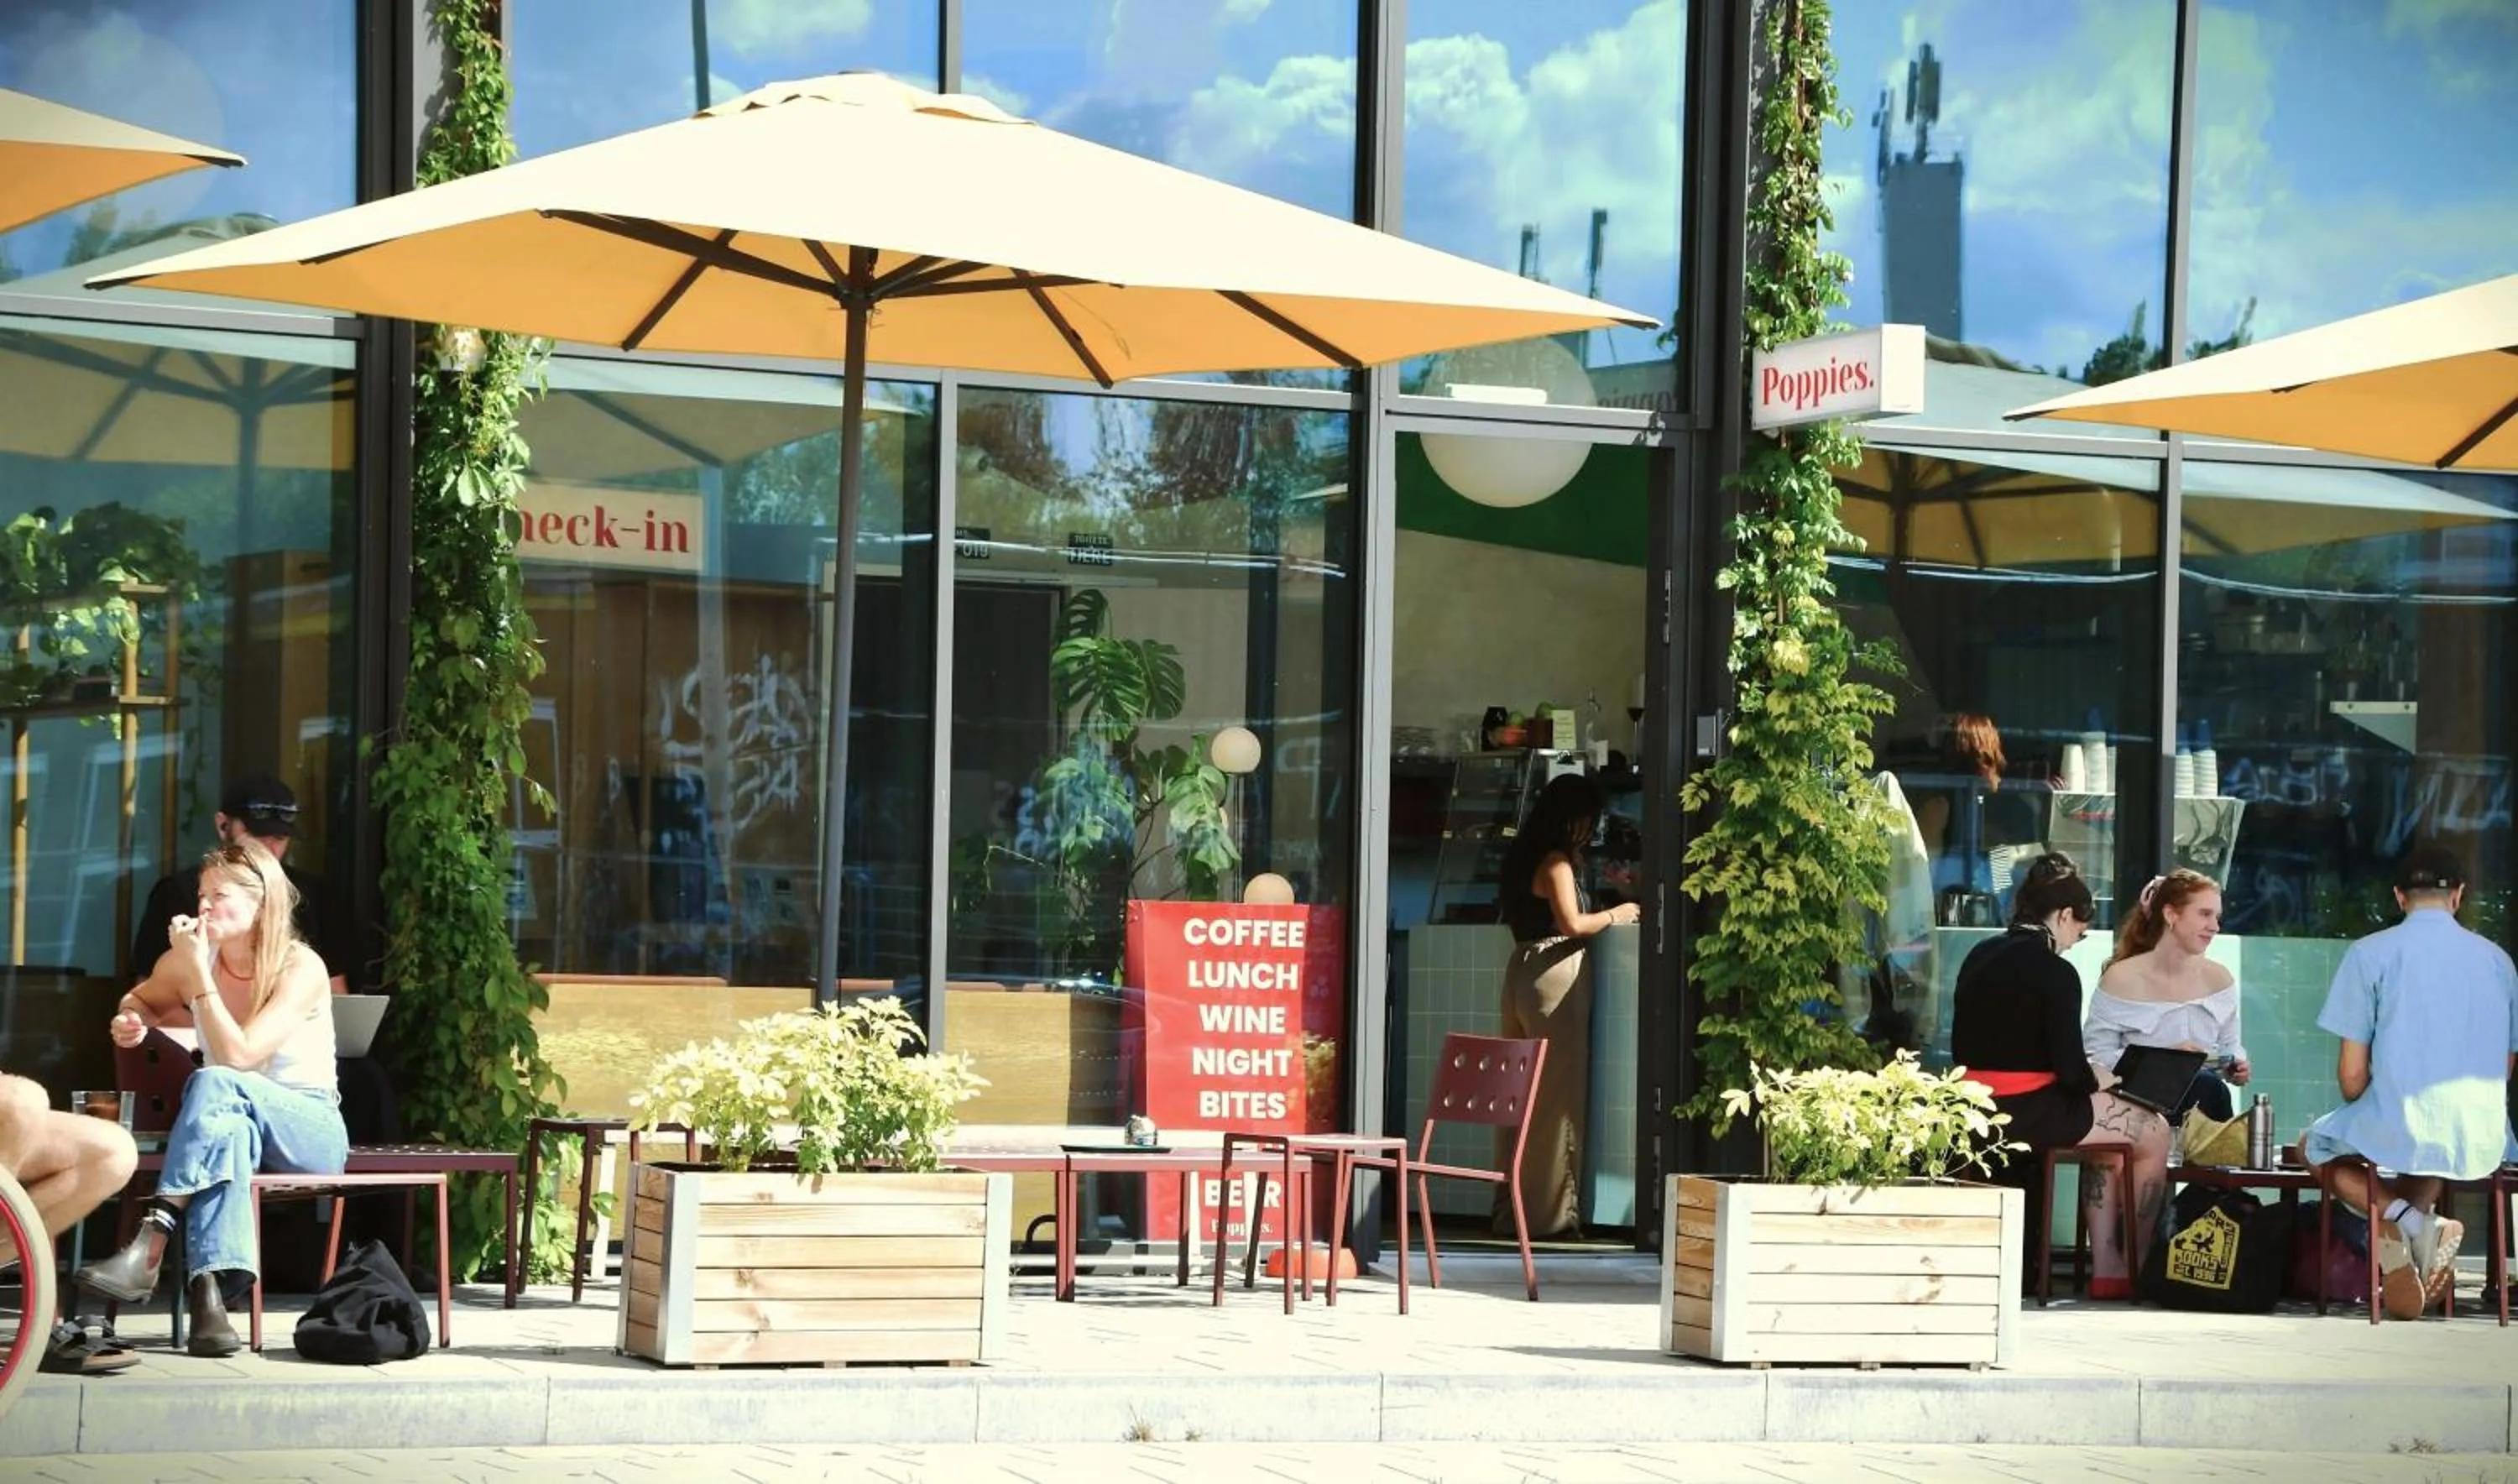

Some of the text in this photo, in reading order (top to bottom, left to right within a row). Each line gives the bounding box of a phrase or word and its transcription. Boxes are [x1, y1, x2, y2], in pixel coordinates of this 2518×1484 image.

[1763, 356, 1873, 410] Poppies.
[1184, 918, 1305, 948] COFFEE
[1188, 959, 1298, 990] LUNCH
[1199, 1004, 1286, 1034] WINE
[1193, 1048, 1293, 1076] NIGHT
[1200, 1090, 1286, 1119] BITES
[1204, 1179, 1282, 1208] BER
